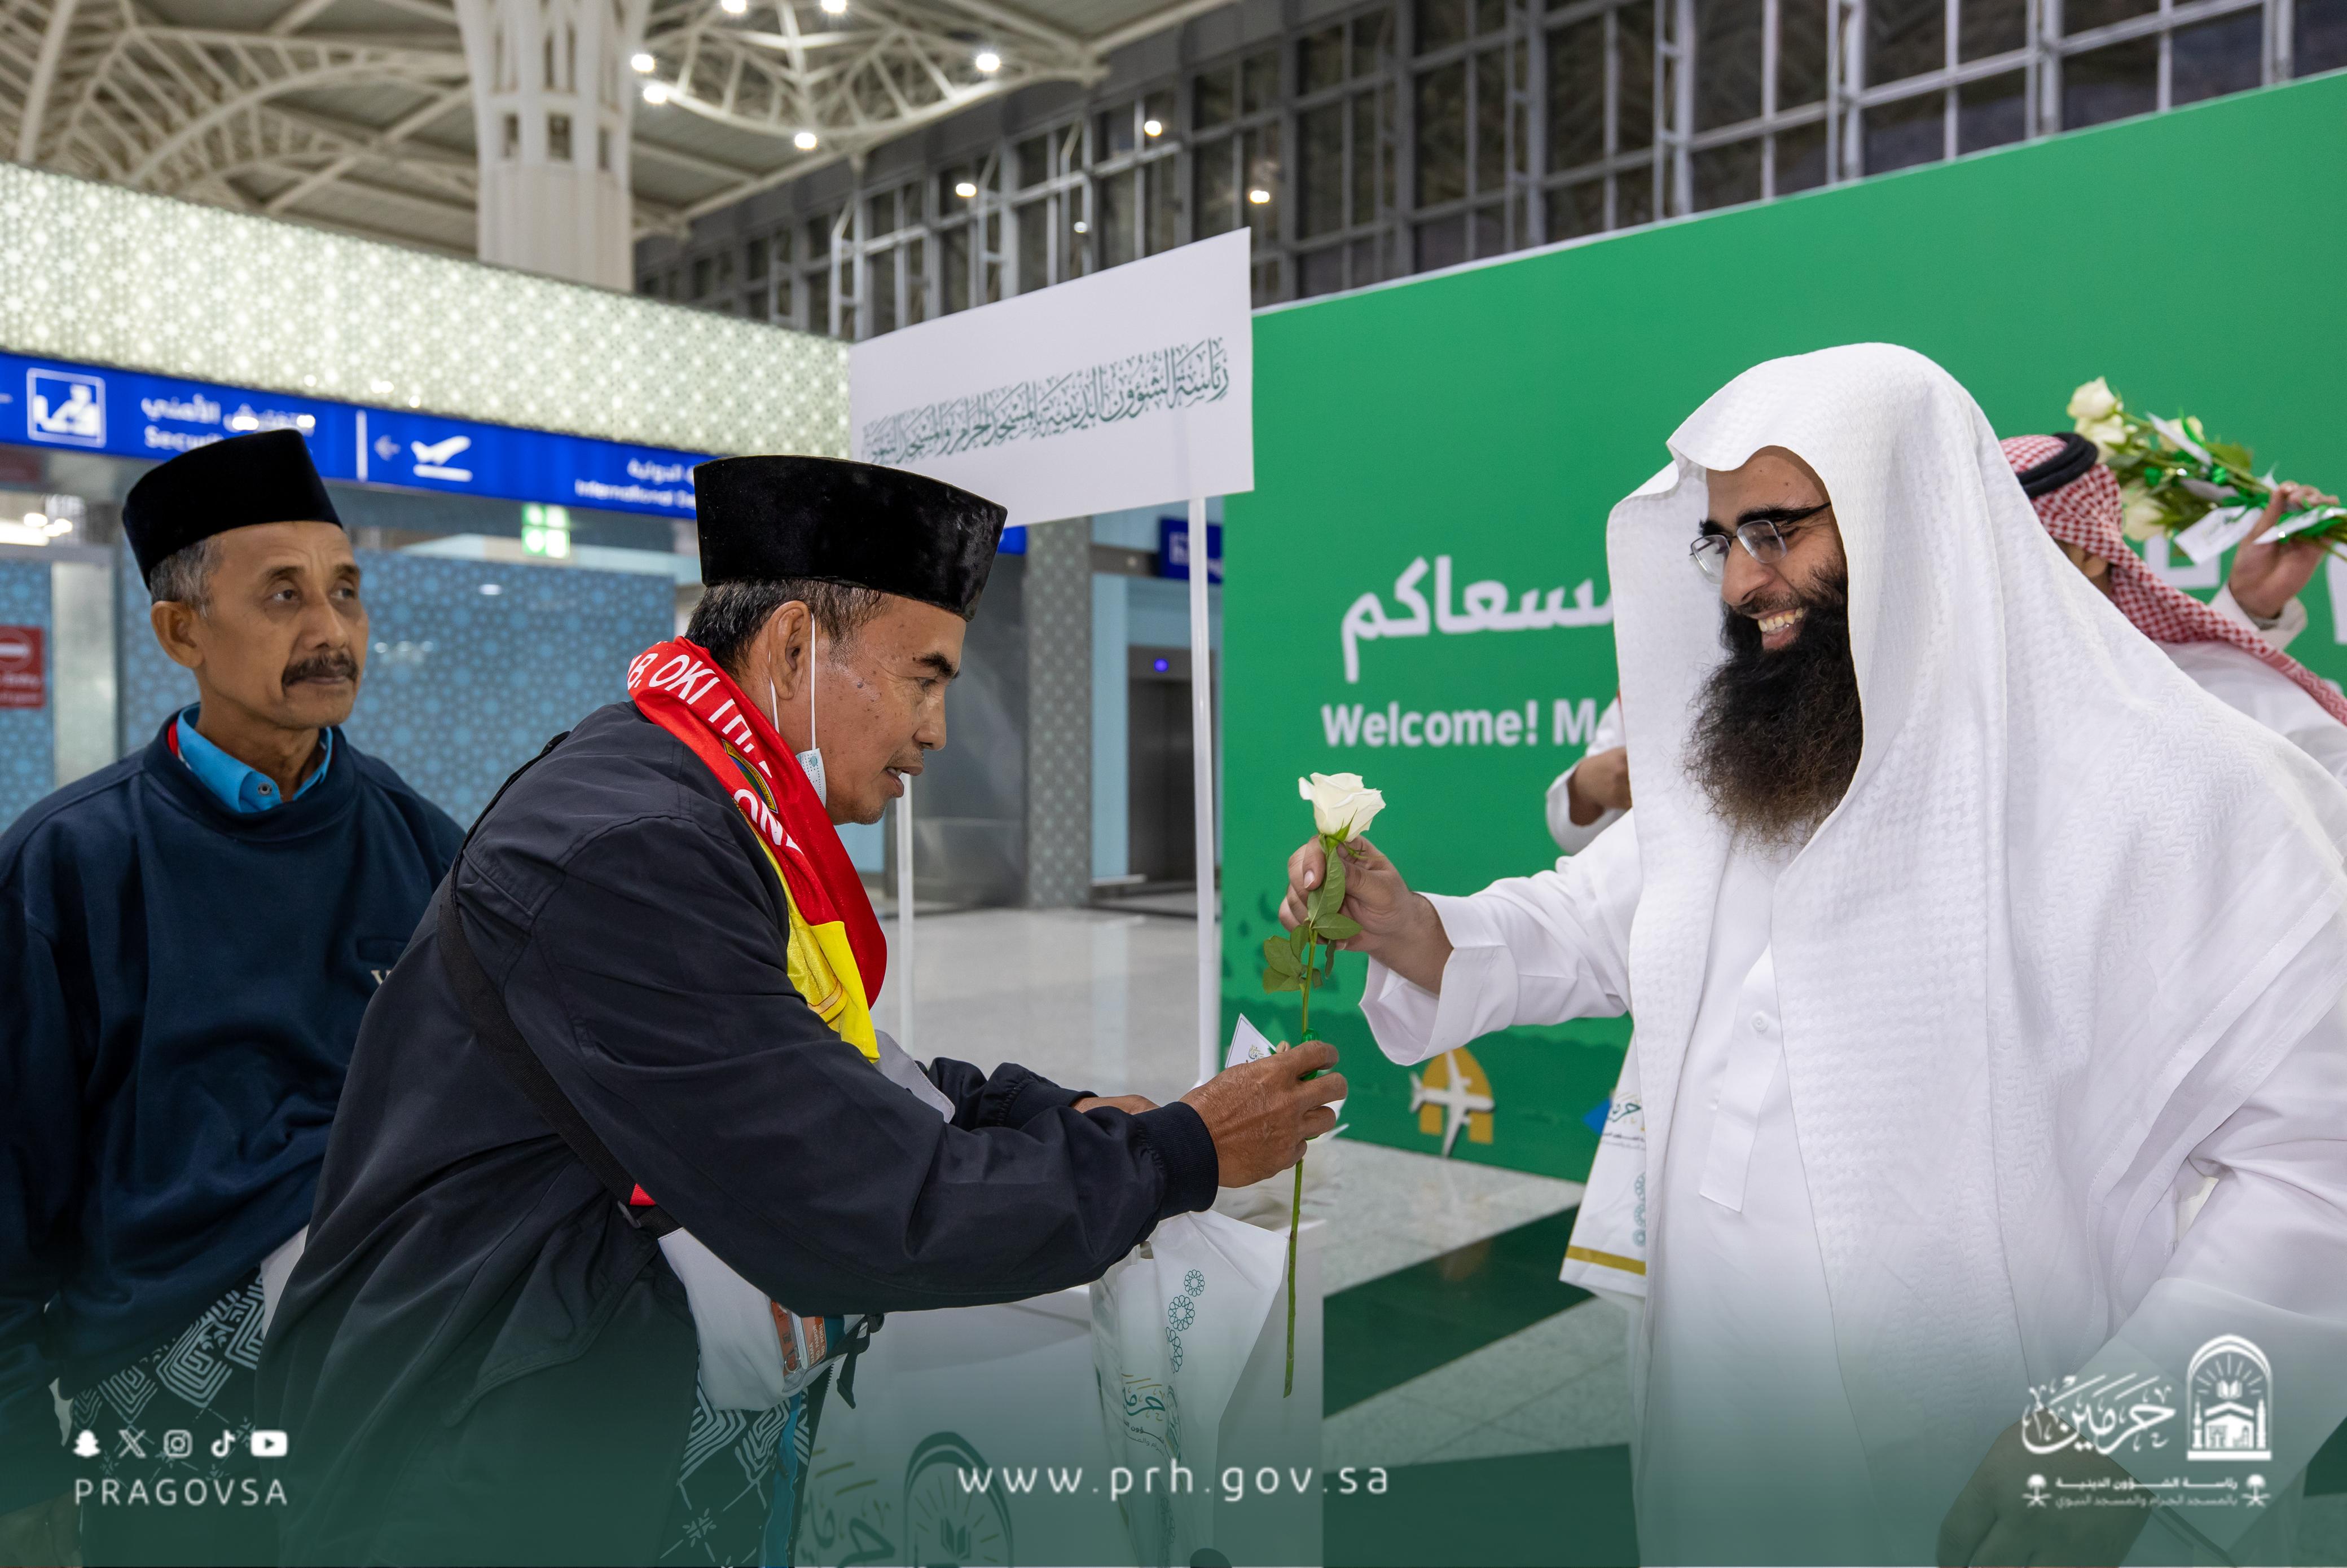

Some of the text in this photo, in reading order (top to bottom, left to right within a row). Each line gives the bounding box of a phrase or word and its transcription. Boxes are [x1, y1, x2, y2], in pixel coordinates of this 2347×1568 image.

[648, 654, 720, 705] OKI
[1321, 698, 1597, 746] Welcome! M
